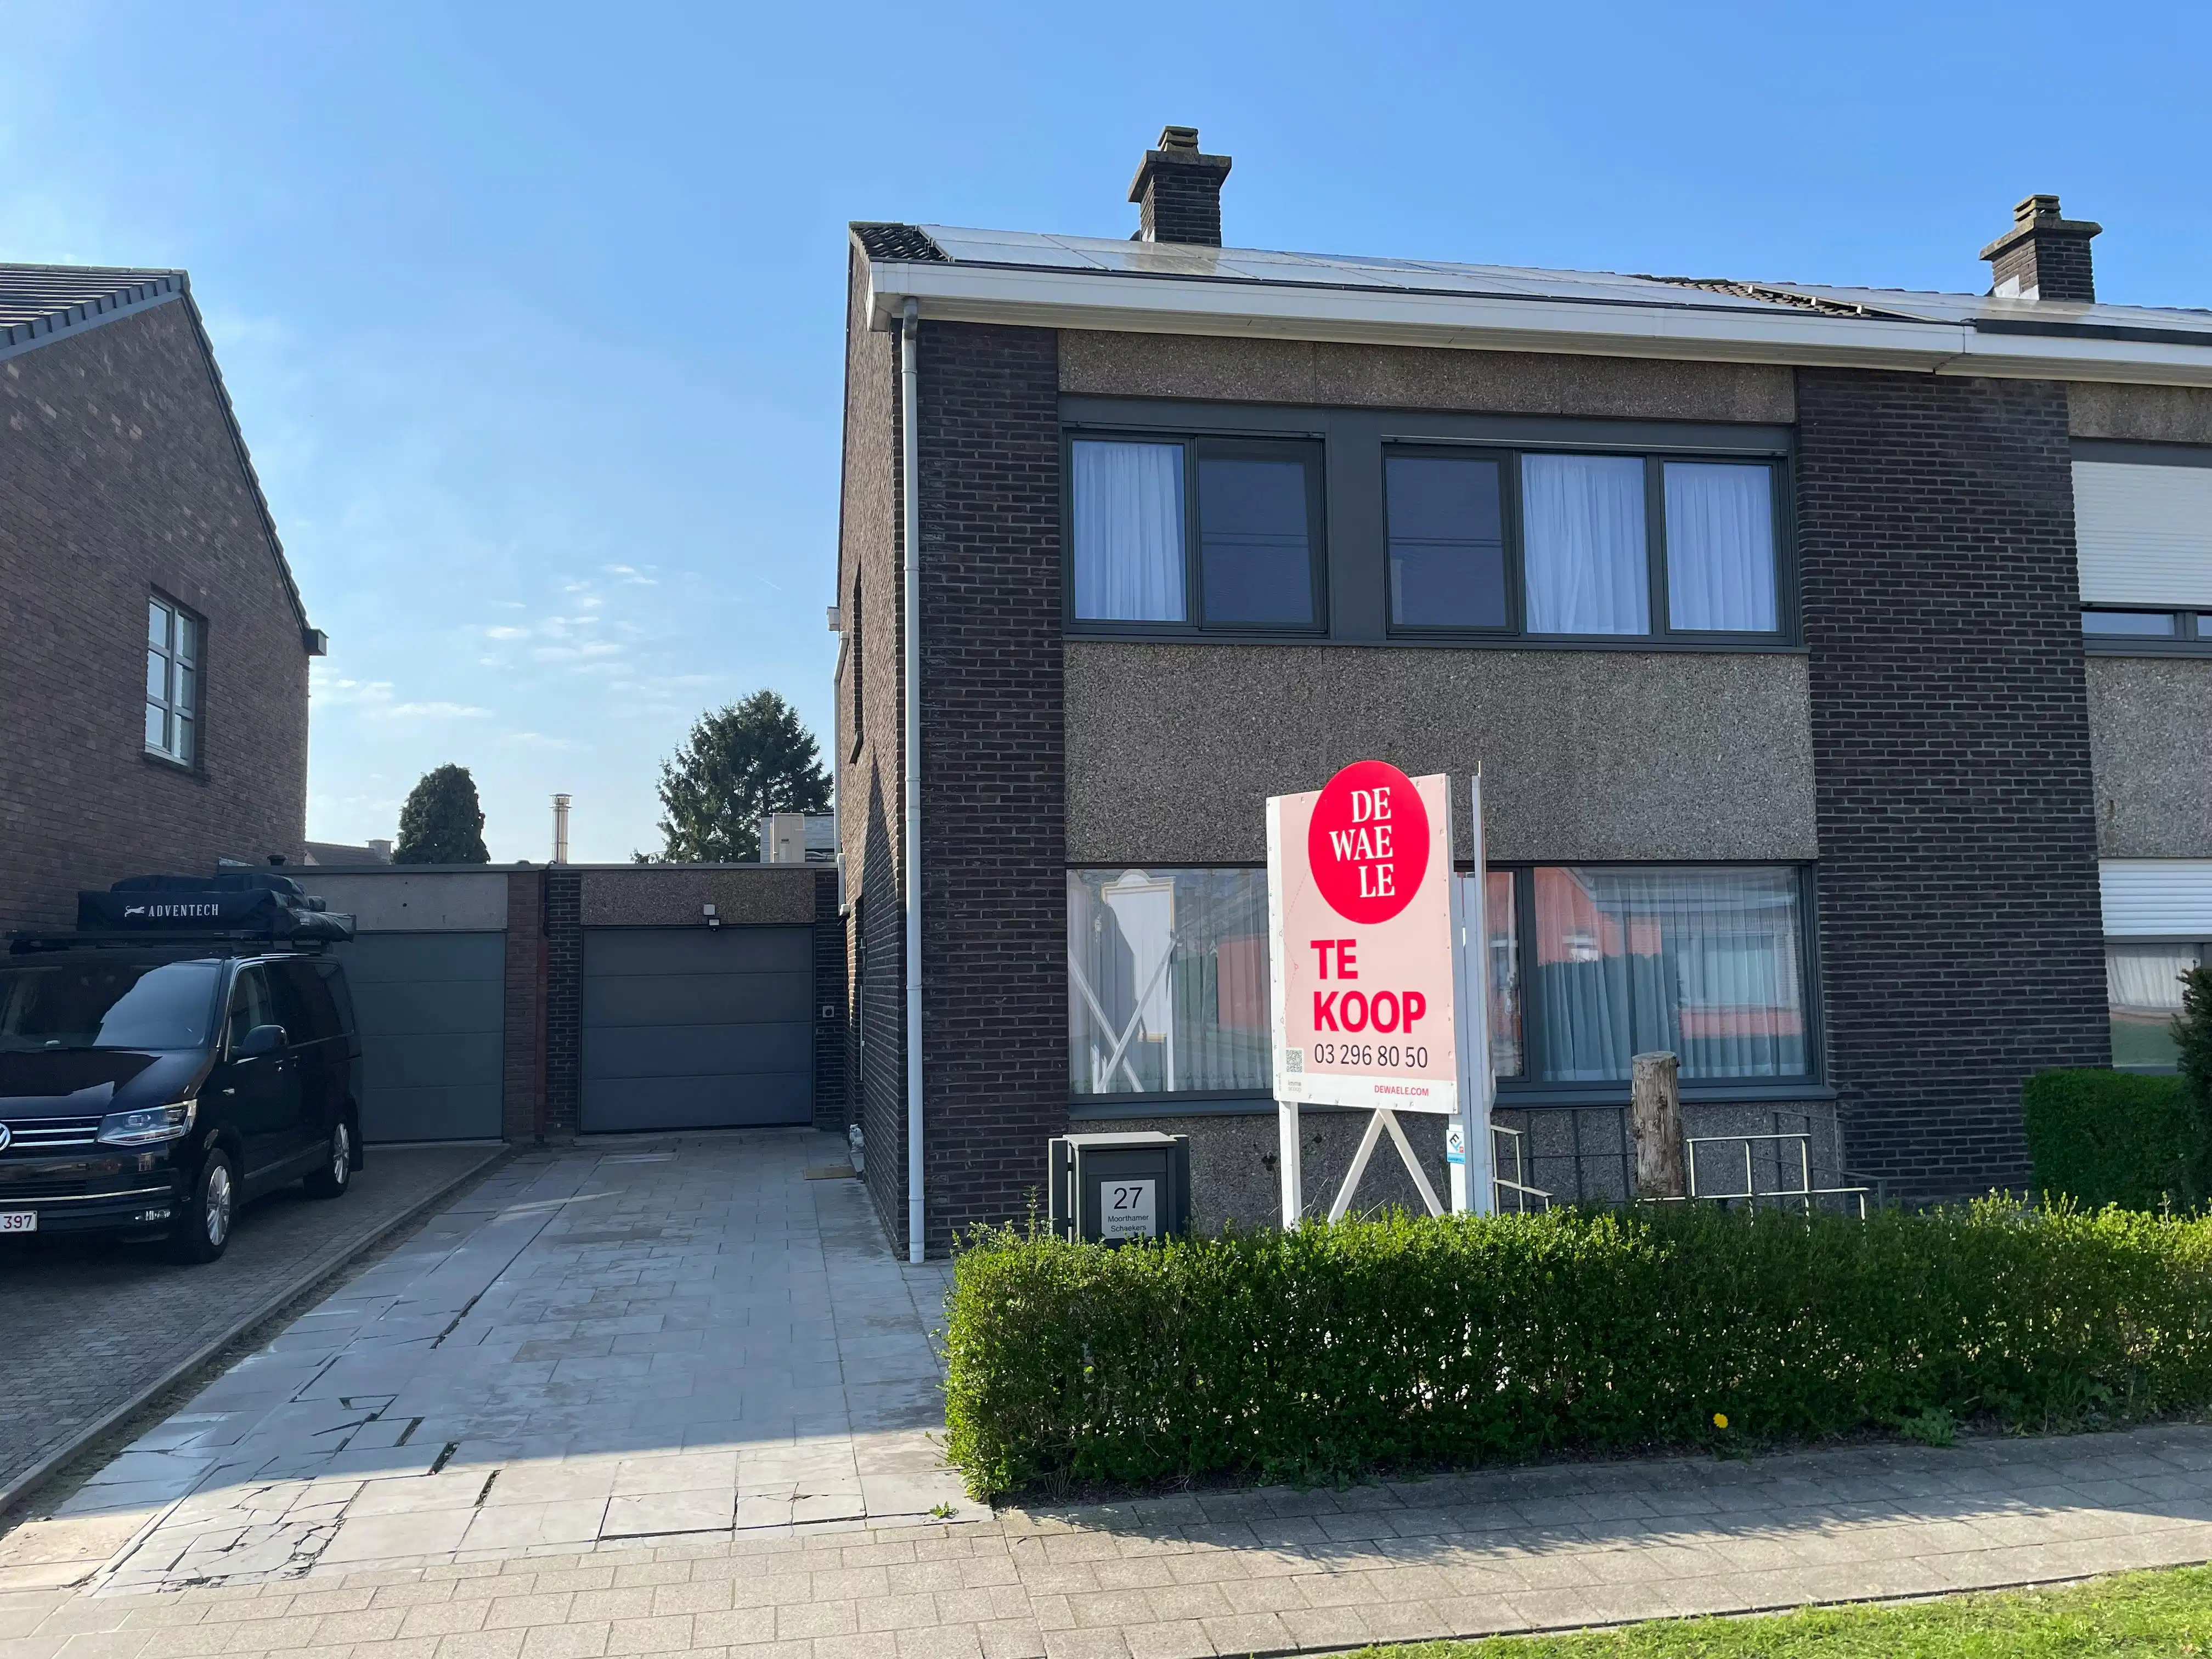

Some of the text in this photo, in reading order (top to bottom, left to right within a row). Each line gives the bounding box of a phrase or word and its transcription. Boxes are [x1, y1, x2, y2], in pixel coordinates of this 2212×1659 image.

[1350, 787, 1391, 822] DE
[1328, 825, 1393, 862] WAE
[1358, 864, 1395, 898] LE
[148, 904, 218, 917] ADVENTECH
[1310, 939, 1358, 979] TE
[1313, 990, 1426, 1034] KOOP
[1314, 1043, 1427, 1068] 03 296 80 50
[1374, 1085, 1429, 1096] DEWAELE.COM
[1113, 1187, 1143, 1210] 27
[3, 1215, 32, 1229] 397
[1108, 1215, 1149, 1223] Moorthamer
